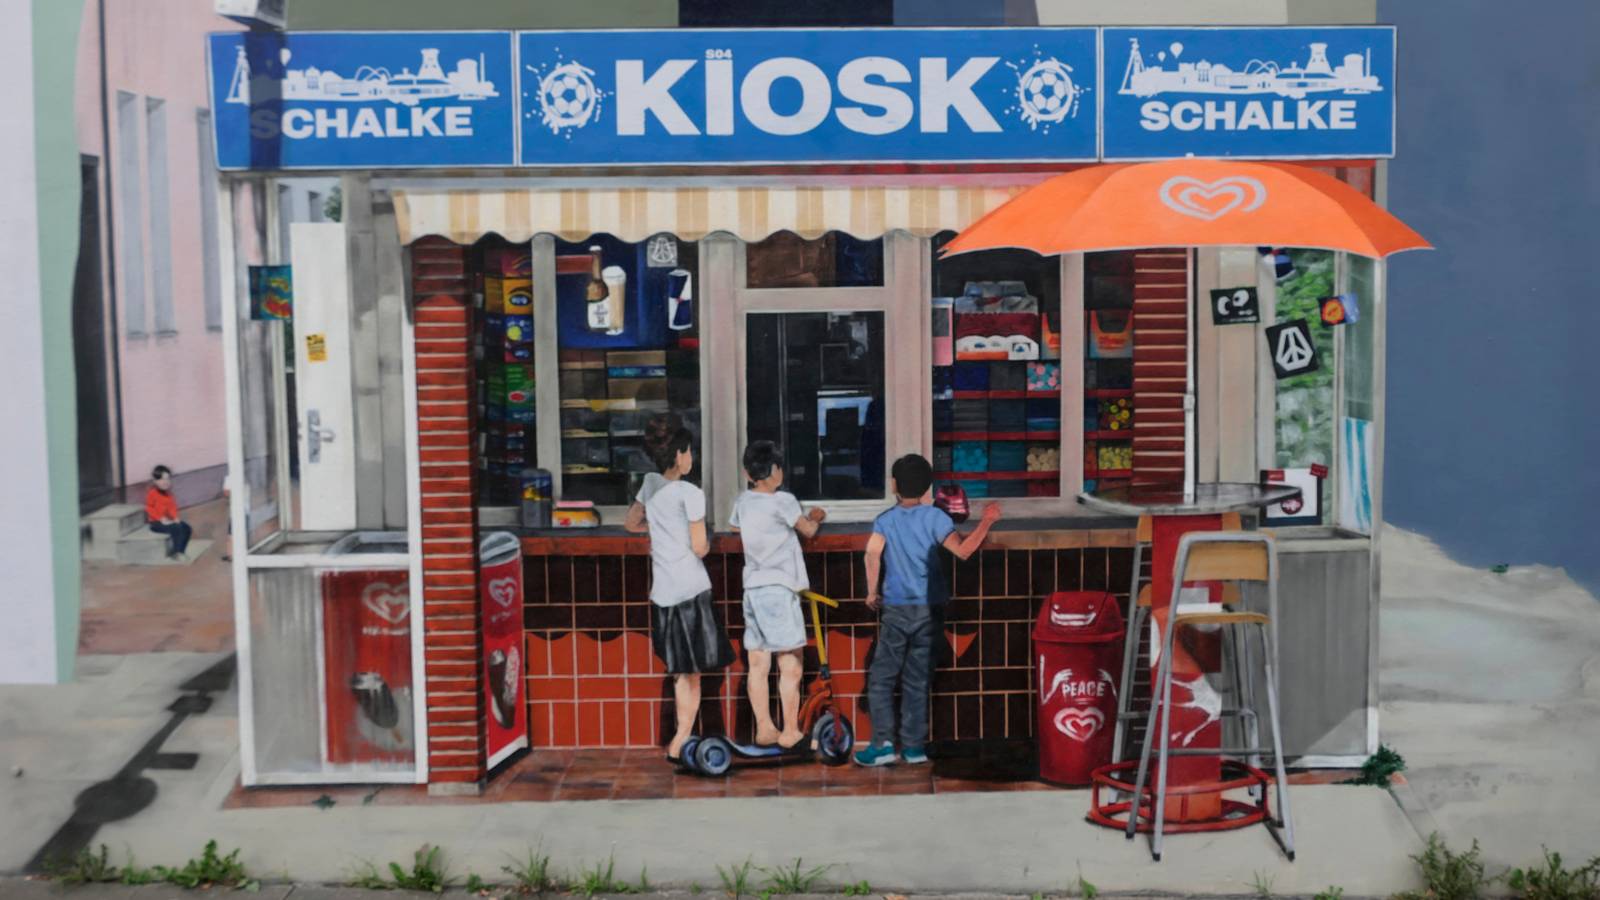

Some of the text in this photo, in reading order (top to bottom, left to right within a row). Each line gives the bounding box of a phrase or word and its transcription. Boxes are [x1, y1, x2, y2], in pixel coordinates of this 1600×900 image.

[705, 48, 733, 59] S04
[615, 57, 1003, 137] KIOSK
[251, 106, 474, 139] SCHALKE
[1139, 99, 1358, 132] SCHALKE
[1062, 681, 1106, 698] PEACE
